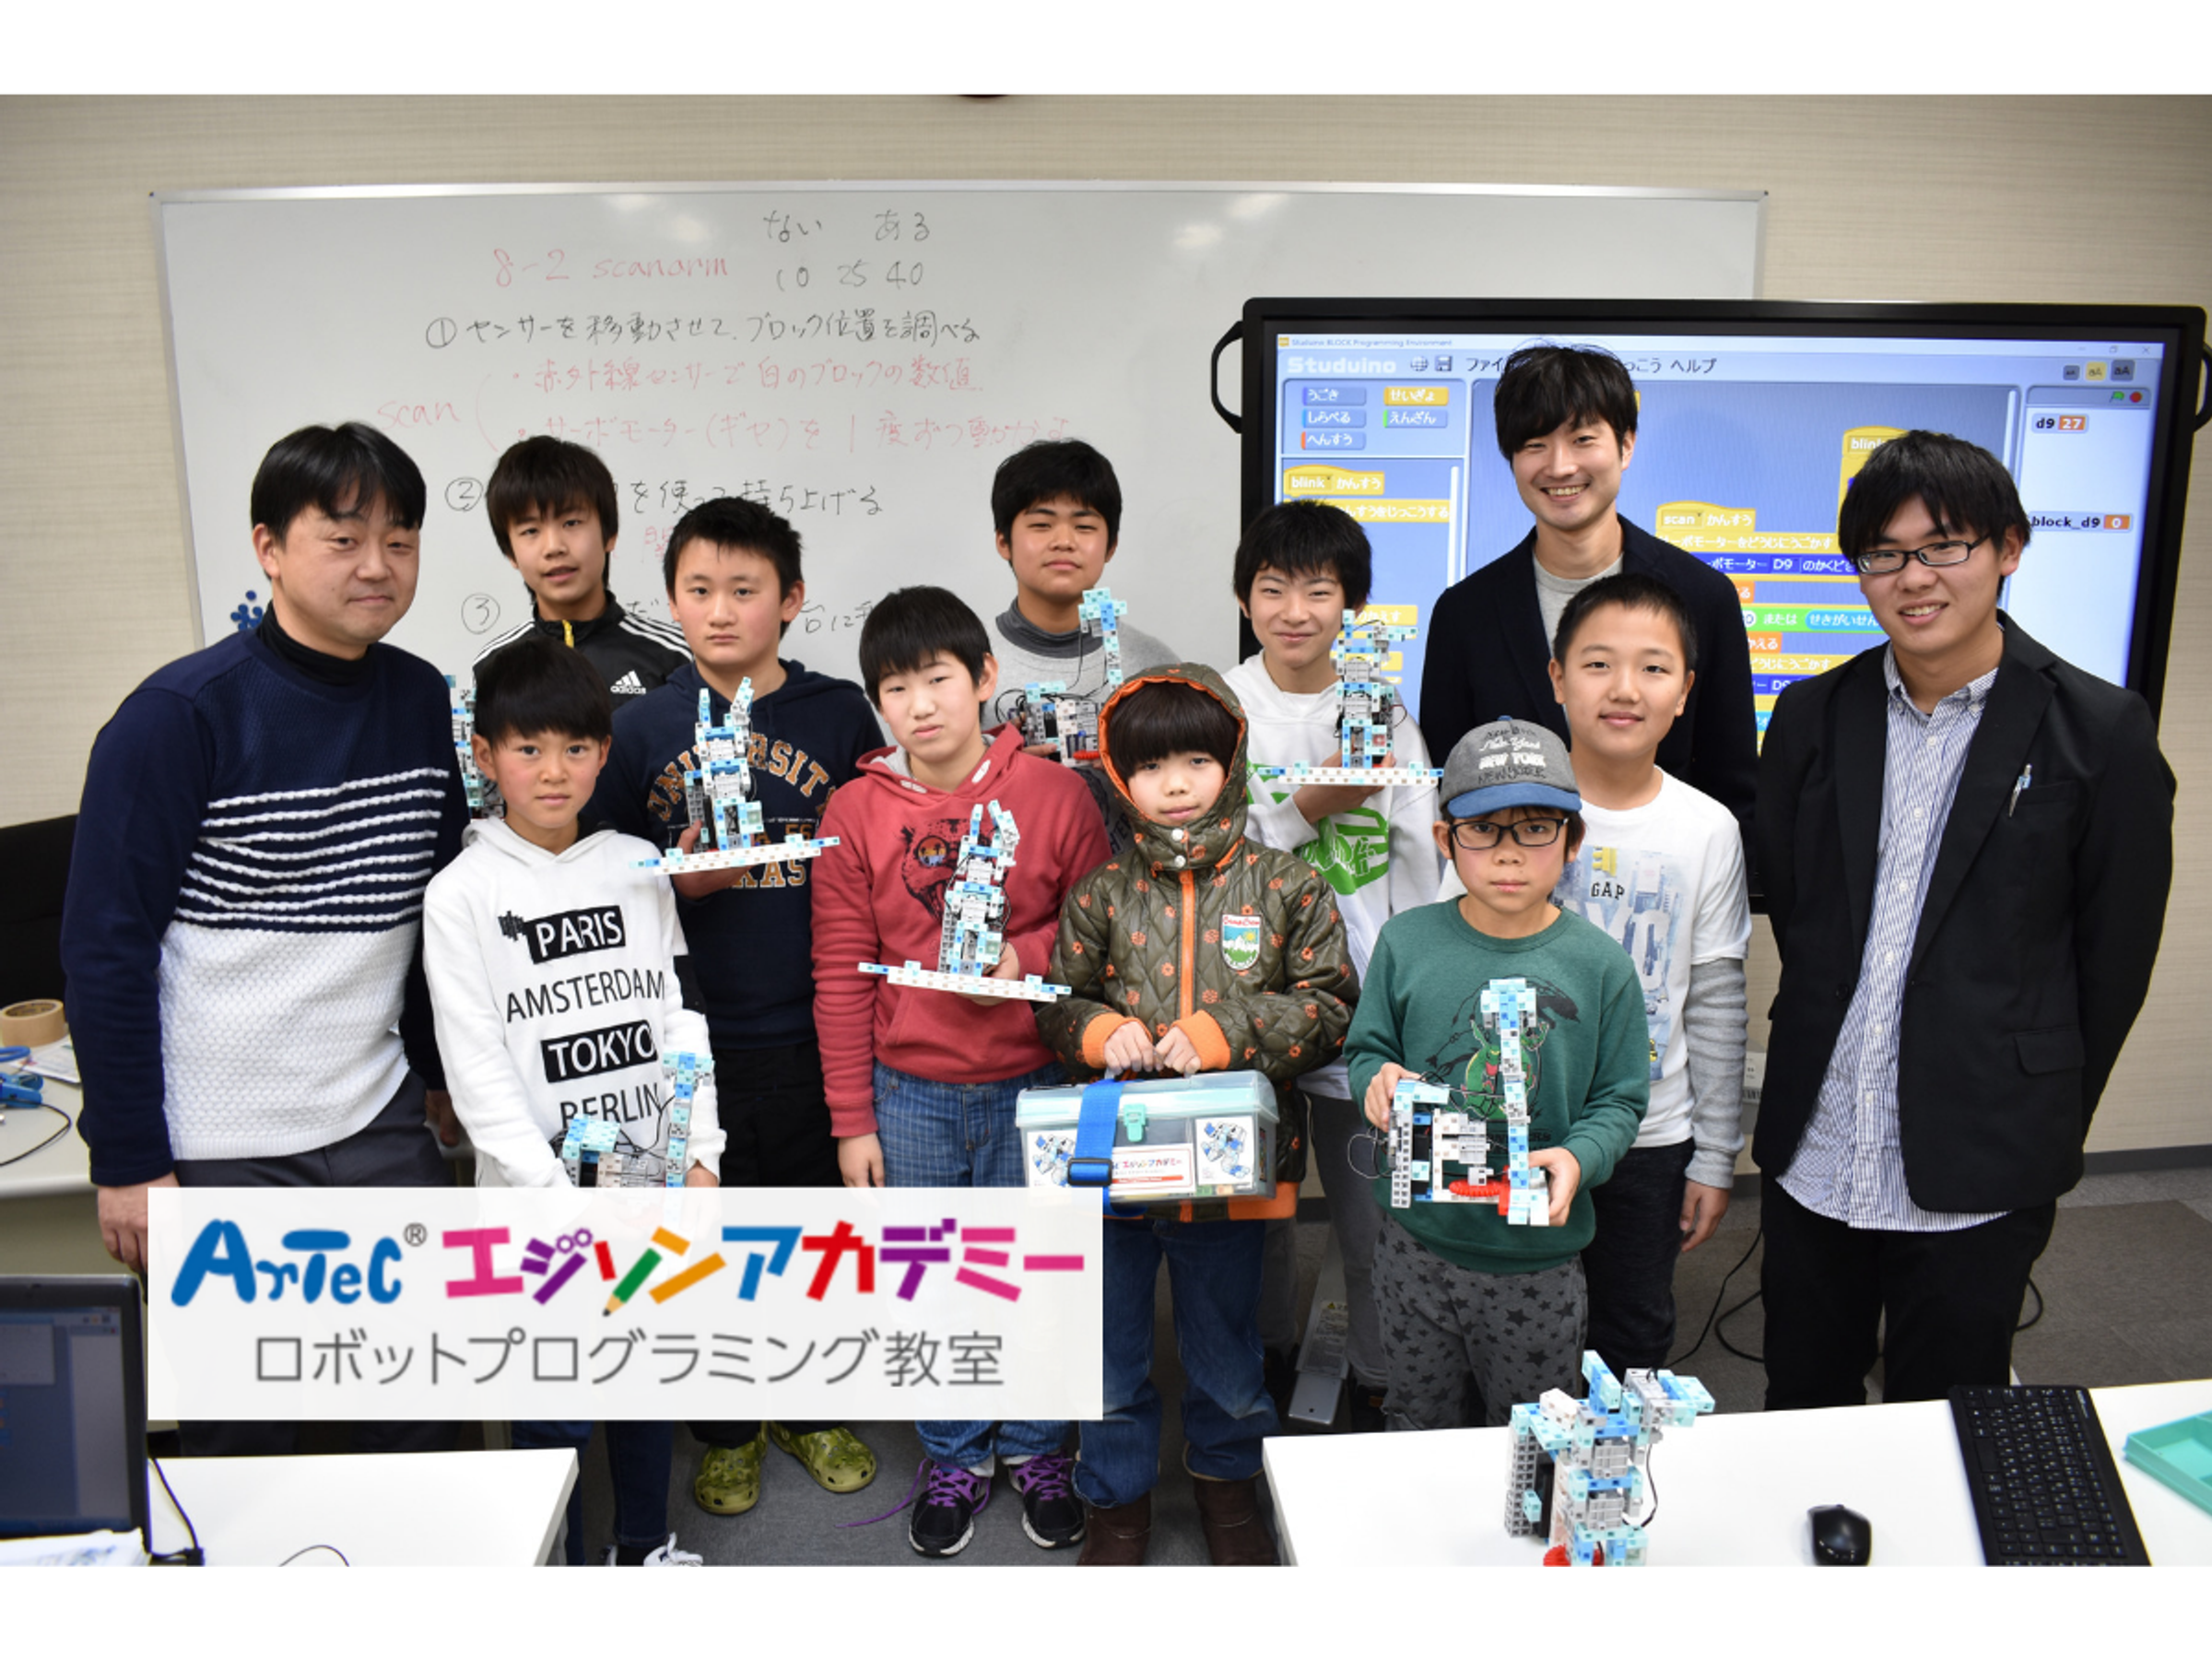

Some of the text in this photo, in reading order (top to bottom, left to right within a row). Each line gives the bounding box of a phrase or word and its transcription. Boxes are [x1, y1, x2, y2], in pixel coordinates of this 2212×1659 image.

[762, 208, 930, 243] ない ある
[492, 247, 571, 288] 8-2
[836, 259, 868, 288] 25
[885, 259, 924, 290] 40
[1327, 338, 1352, 347] BLOCK
[1353, 338, 1405, 348] Programming
[1406, 338, 1453, 347] Environment
[1287, 356, 1397, 374] Studuino
[1465, 357, 1718, 374] ファイ っこう ヘルプ
[1307, 388, 1339, 402] うごき
[1390, 388, 1436, 402] せいぎょ
[376, 399, 460, 431] scan
[1308, 411, 1351, 424] しらべる
[2035, 418, 2083, 429] d9 27
[1306, 432, 1353, 447] へんすう
[1290, 476, 1382, 490] blink かんすう
[1338, 504, 1450, 519] んすうをじっこうする
[1663, 513, 1752, 526] scan かんすう
[2031, 515, 2123, 530] block_d9 0
[1772, 559, 1793, 571] D9
[1762, 613, 1798, 626] または
[610, 685, 647, 696] adidas
[647, 732, 841, 821] UNIRSIT
[1590, 881, 1626, 900] GAP
[535, 911, 624, 958] PARIS
[506, 968, 665, 1024] AMSTERDAM
[547, 1024, 655, 1077] TOKYO
